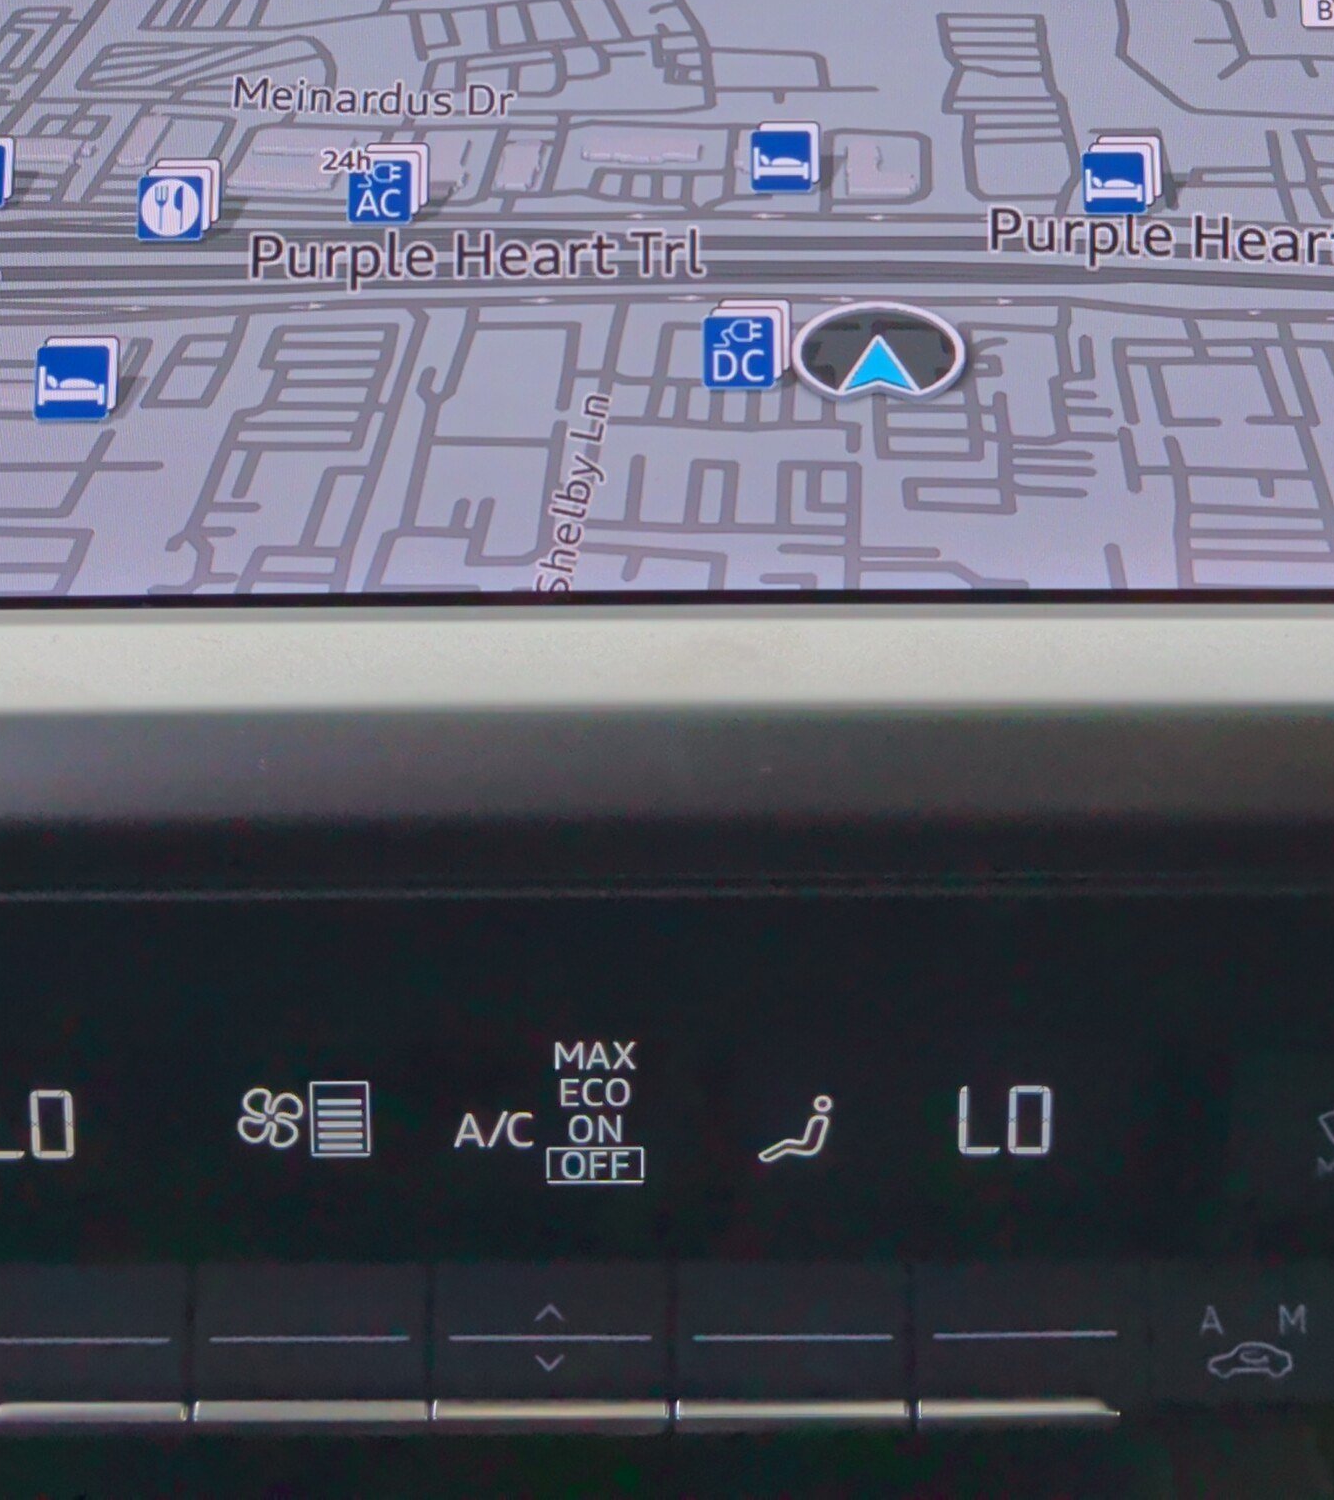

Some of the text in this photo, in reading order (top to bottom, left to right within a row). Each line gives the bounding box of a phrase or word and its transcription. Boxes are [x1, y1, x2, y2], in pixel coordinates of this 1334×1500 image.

[233, 76, 515, 117] Meinardus Dr
[321, 150, 372, 171] 24h
[355, 189, 402, 219] AC
[989, 208, 1172, 266] Purple
[252, 230, 704, 290] Purple Heart Trl
[711, 348, 766, 383] DC
[536, 394, 610, 592] Shelby Ln
[554, 1041, 636, 1070] MAX
[558, 1078, 631, 1108] ECO
[454, 1111, 535, 1150] A/C
[568, 1114, 623, 1144] ON
[560, 1151, 631, 1181] OFF
[1199, 1304, 1309, 1336] A M
